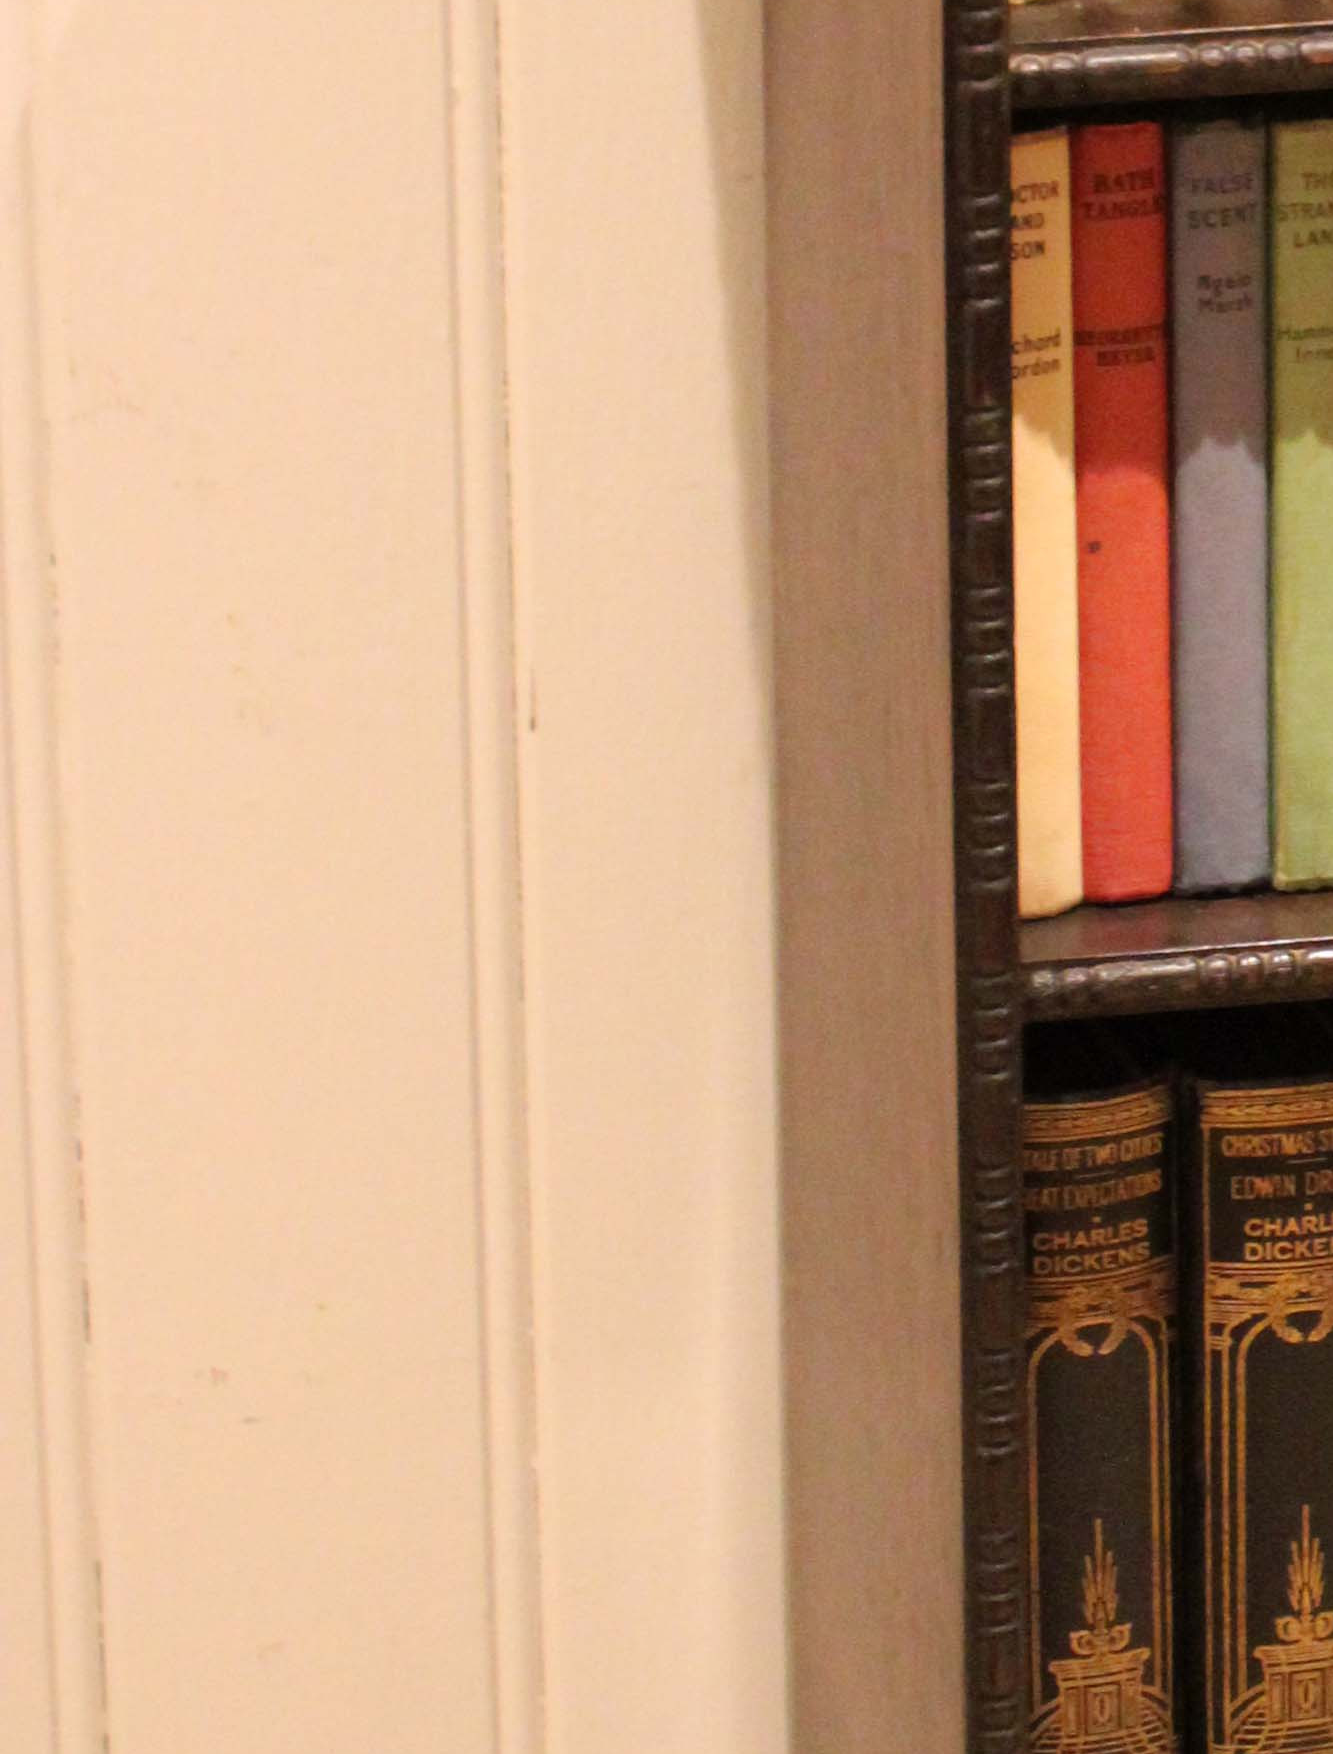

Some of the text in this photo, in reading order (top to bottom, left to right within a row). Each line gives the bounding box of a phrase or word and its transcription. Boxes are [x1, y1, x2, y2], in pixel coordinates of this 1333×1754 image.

[1231, 1175, 1296, 1201] EDWIN
[1033, 1218, 1149, 1252] CHARLES
[1033, 1241, 1151, 1275] DICKENS
